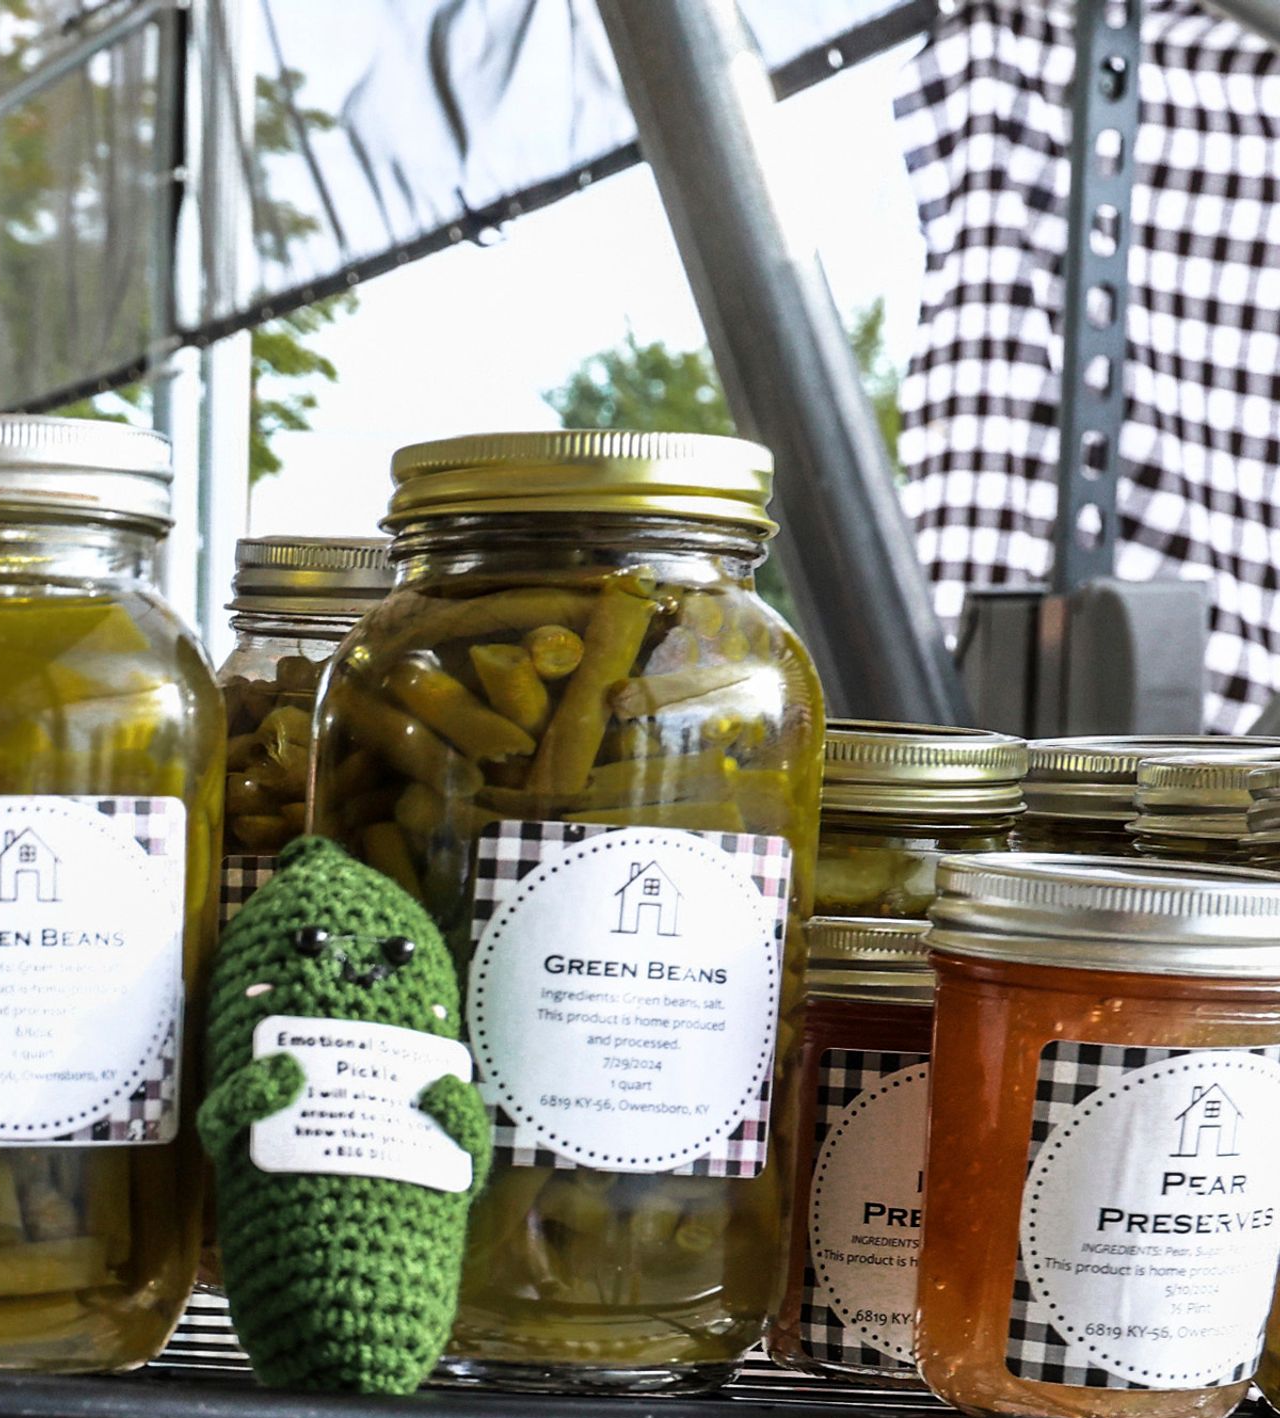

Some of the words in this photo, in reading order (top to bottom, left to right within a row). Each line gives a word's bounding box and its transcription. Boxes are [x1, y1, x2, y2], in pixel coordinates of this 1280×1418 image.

[41, 928, 126, 947] BEANS
[543, 954, 638, 978] GREEN
[647, 961, 728, 985] BEANS
[541, 987, 620, 1004] Ingredients:
[537, 1008, 563, 1022] This
[566, 1011, 618, 1026] product
[621, 1014, 631, 1026] is
[634, 1015, 670, 1028] home
[672, 1019, 726, 1032] produced
[276, 1031, 373, 1050] Emotional
[586, 1034, 611, 1047] and
[336, 1060, 397, 1082] Pickle
[602, 1056, 663, 1072] 7/29/2024
[618, 1079, 652, 1092] quart
[540, 1094, 572, 1110] 6819
[1160, 1171, 1248, 1197] PEAR
[863, 1202, 922, 1228] PRE
[1096, 1206, 1276, 1235] PRESERVES
[823, 1249, 845, 1262] This
[846, 1253, 894, 1267] product
[896, 1256, 906, 1267] is
[1044, 1257, 1072, 1274] This
[1075, 1261, 1132, 1277] product
[1134, 1265, 1146, 1277] is
[1148, 1265, 1187, 1277] home
[856, 1309, 888, 1326] 6819
[1085, 1323, 1122, 1340] 6819
